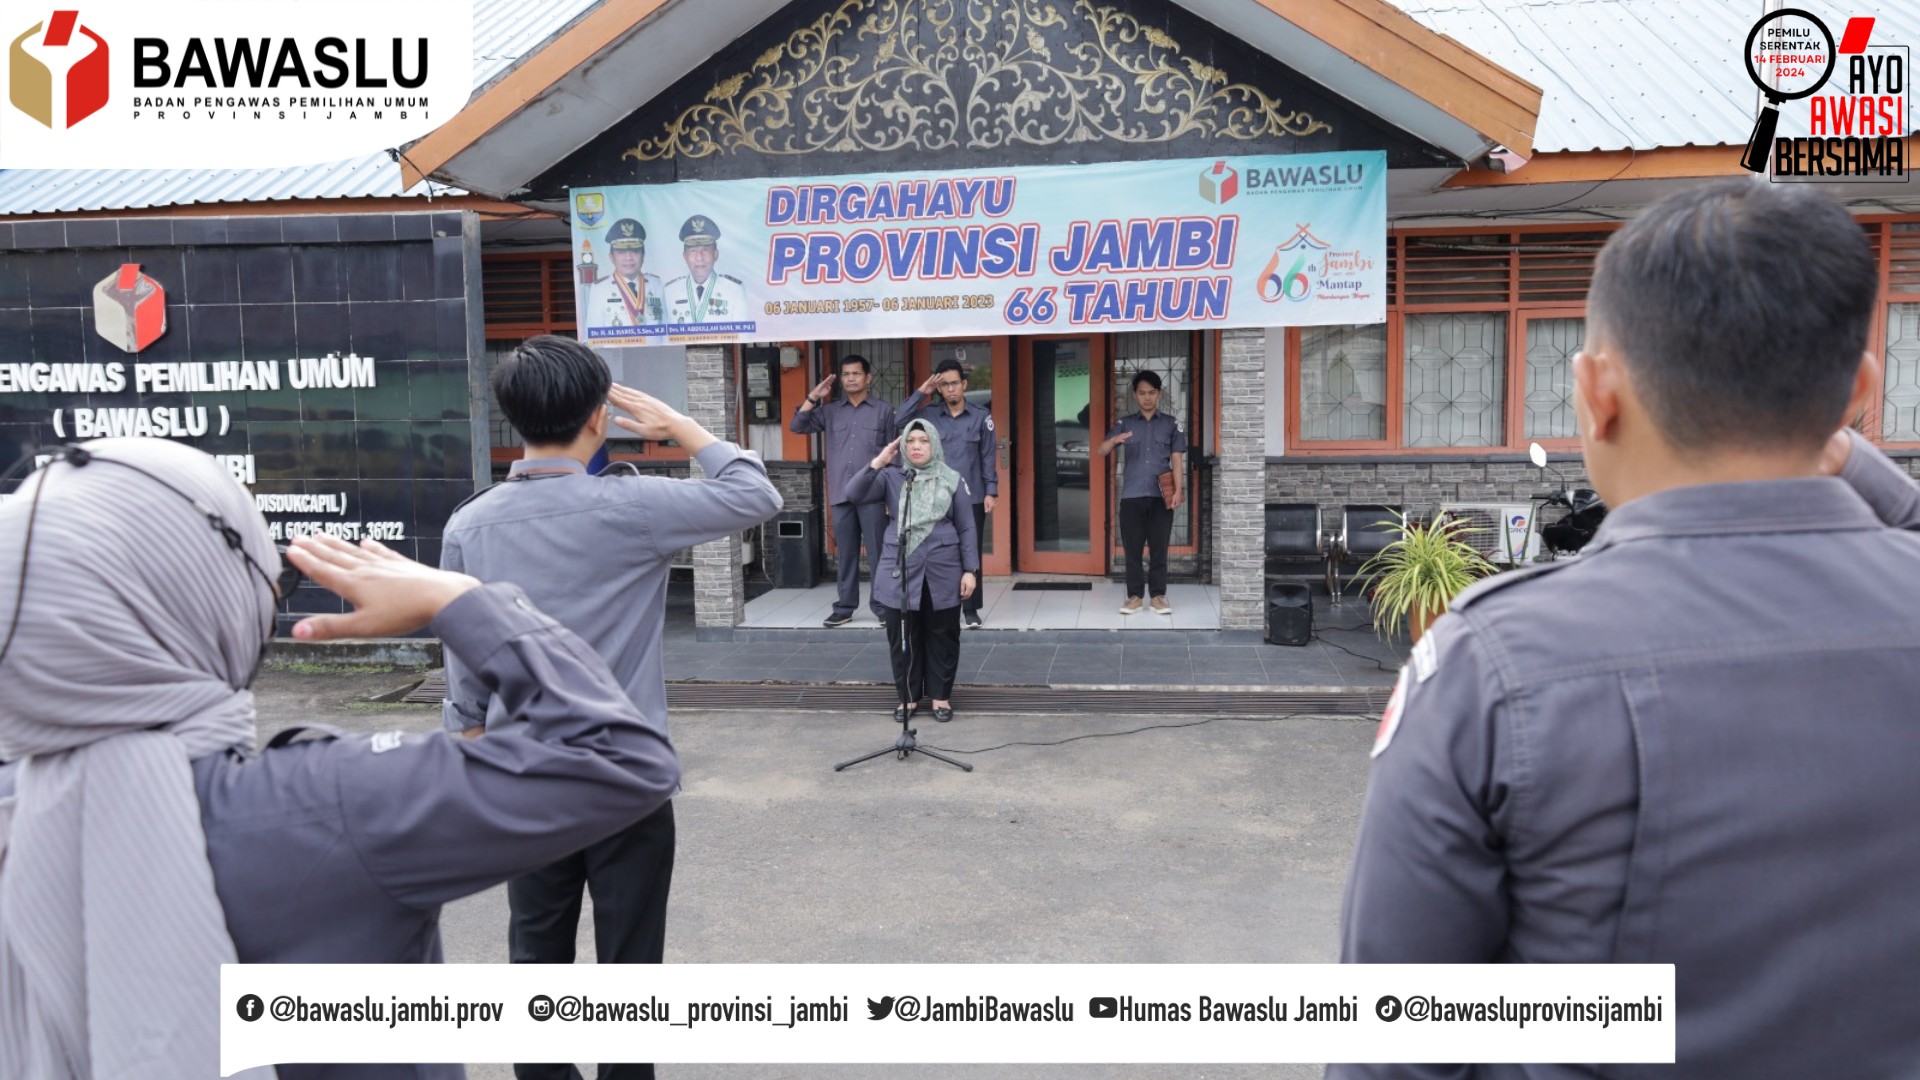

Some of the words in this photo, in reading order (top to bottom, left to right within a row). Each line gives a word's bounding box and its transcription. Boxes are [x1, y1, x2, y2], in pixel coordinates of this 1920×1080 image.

[1246, 164, 1363, 188] BAWASLU
[766, 176, 1016, 226] DIRGAHAYU
[767, 223, 1040, 285] PROVINSI
[1049, 215, 1239, 276] JAMBI
[1318, 250, 1374, 277] Jambi
[1003, 287, 1058, 325] 66
[1064, 276, 1232, 324] TAHUN
[1316, 279, 1362, 291] Mantap
[764, 301, 781, 315] 06
[783, 300, 840, 315] JANUARI
[882, 298, 899, 312] 06
[901, 296, 959, 311] JANUARI
[962, 294, 995, 309] 2023
[135, 360, 280, 392] PEMILIHAN
[287, 357, 376, 389] UMUM
[74, 406, 208, 437] BAWASLU
